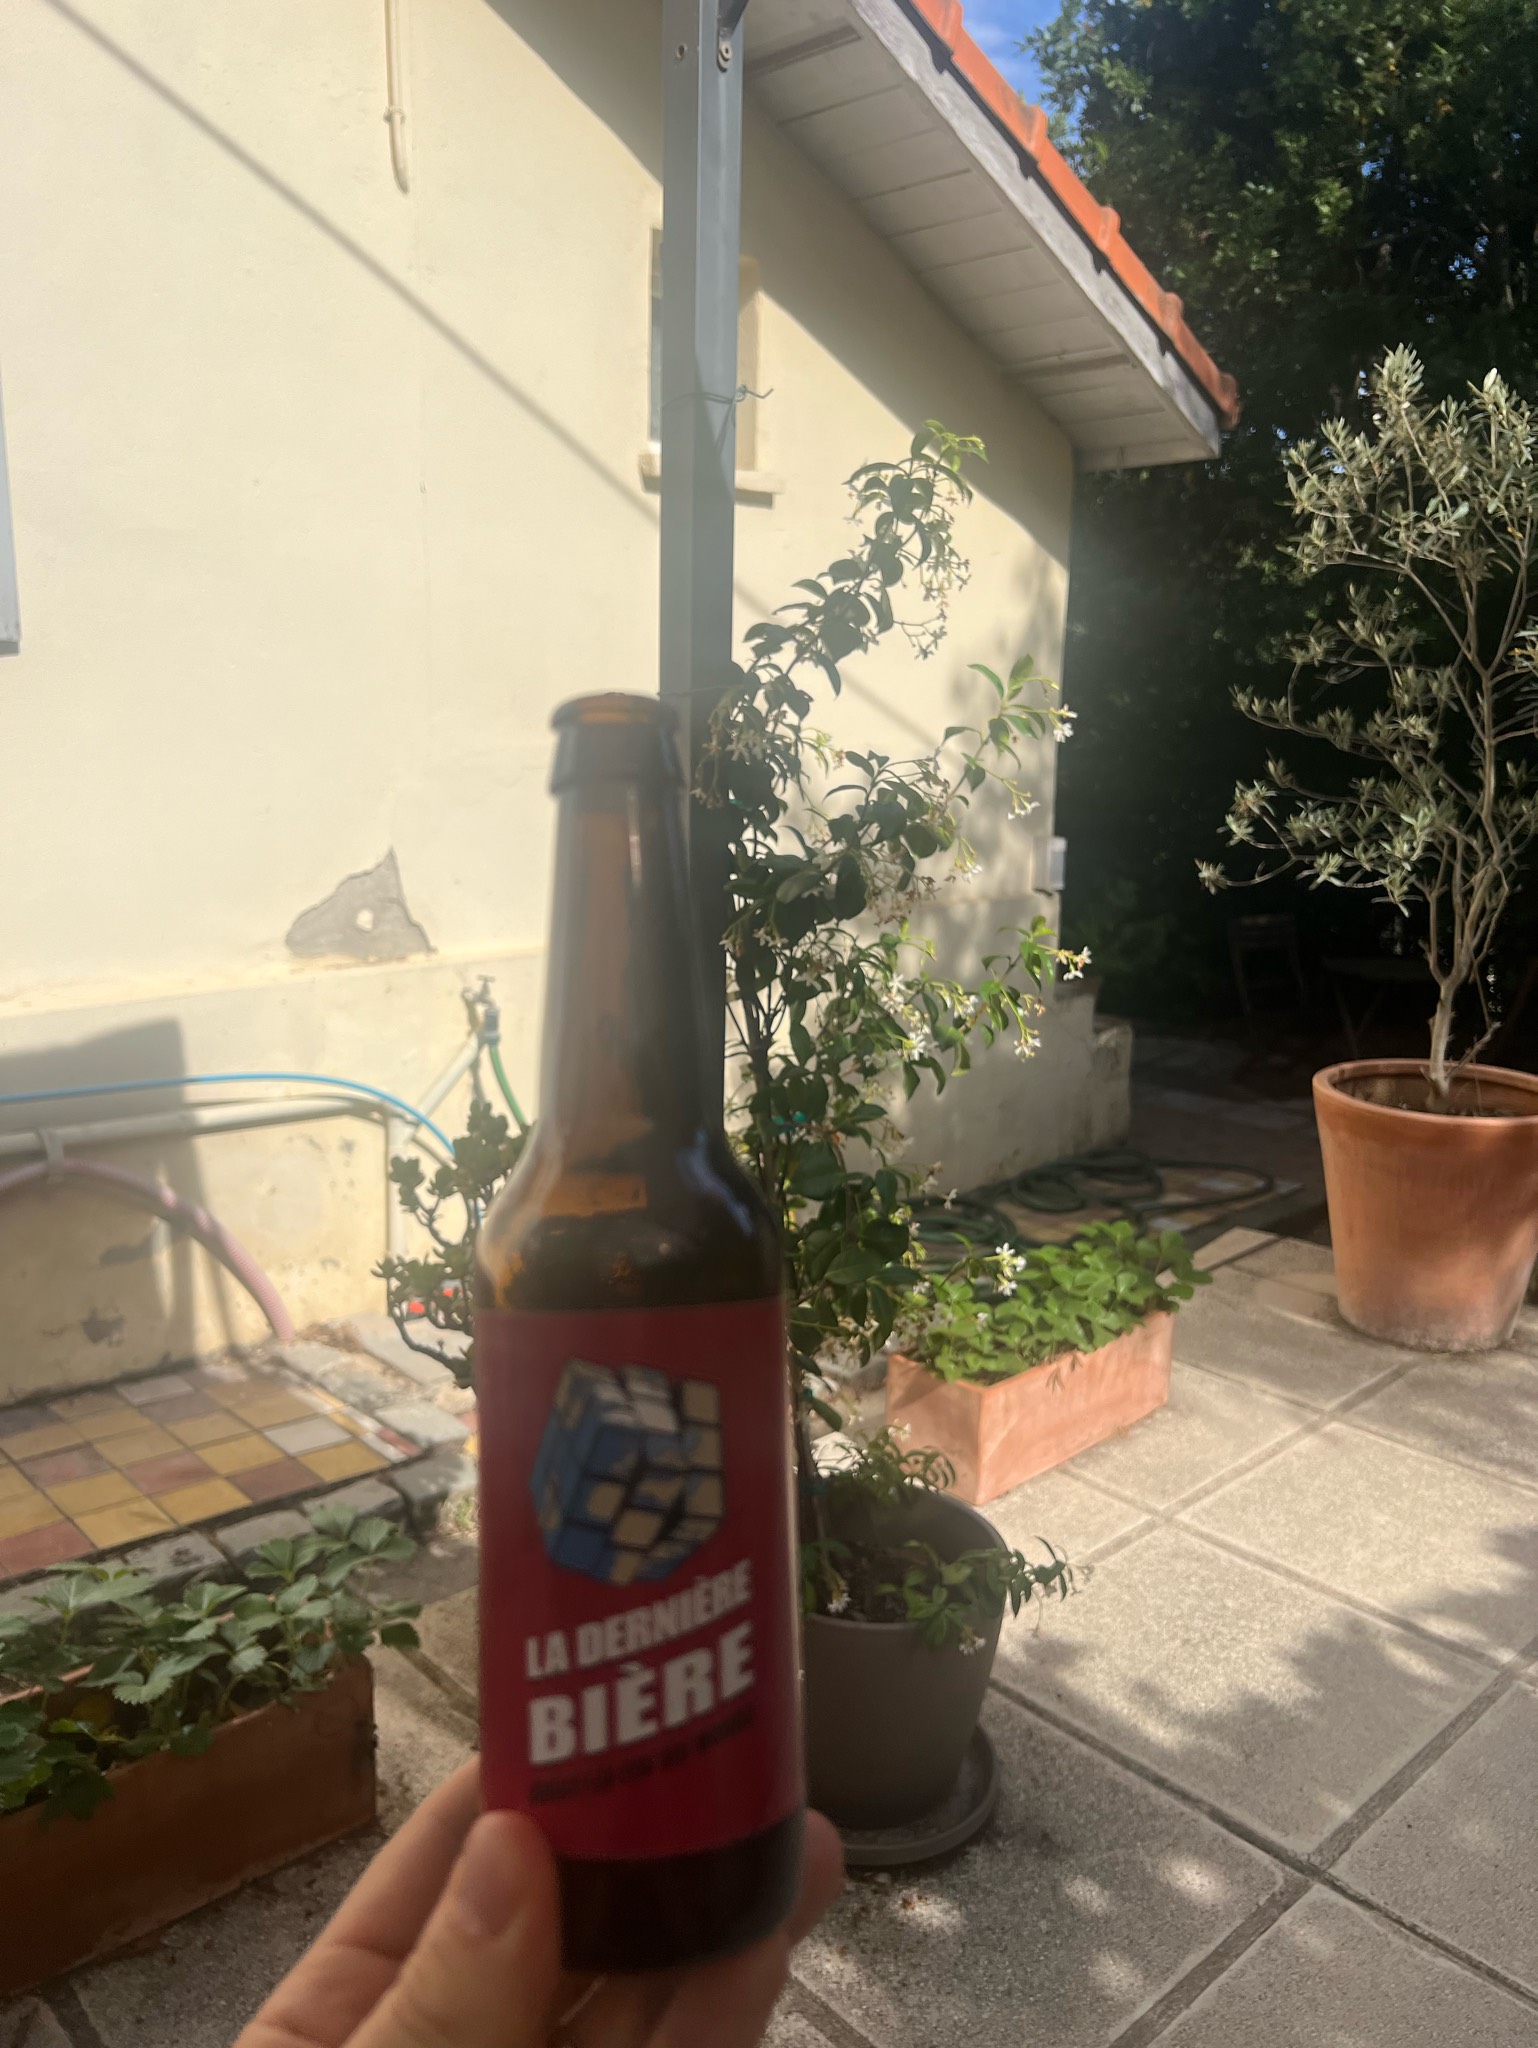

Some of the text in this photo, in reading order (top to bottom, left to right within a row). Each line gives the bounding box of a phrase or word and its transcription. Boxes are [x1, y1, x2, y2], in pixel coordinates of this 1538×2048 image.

[526, 1559, 751, 1681] LA DERNIÈRE
[529, 1621, 754, 1765] BIÈRE
